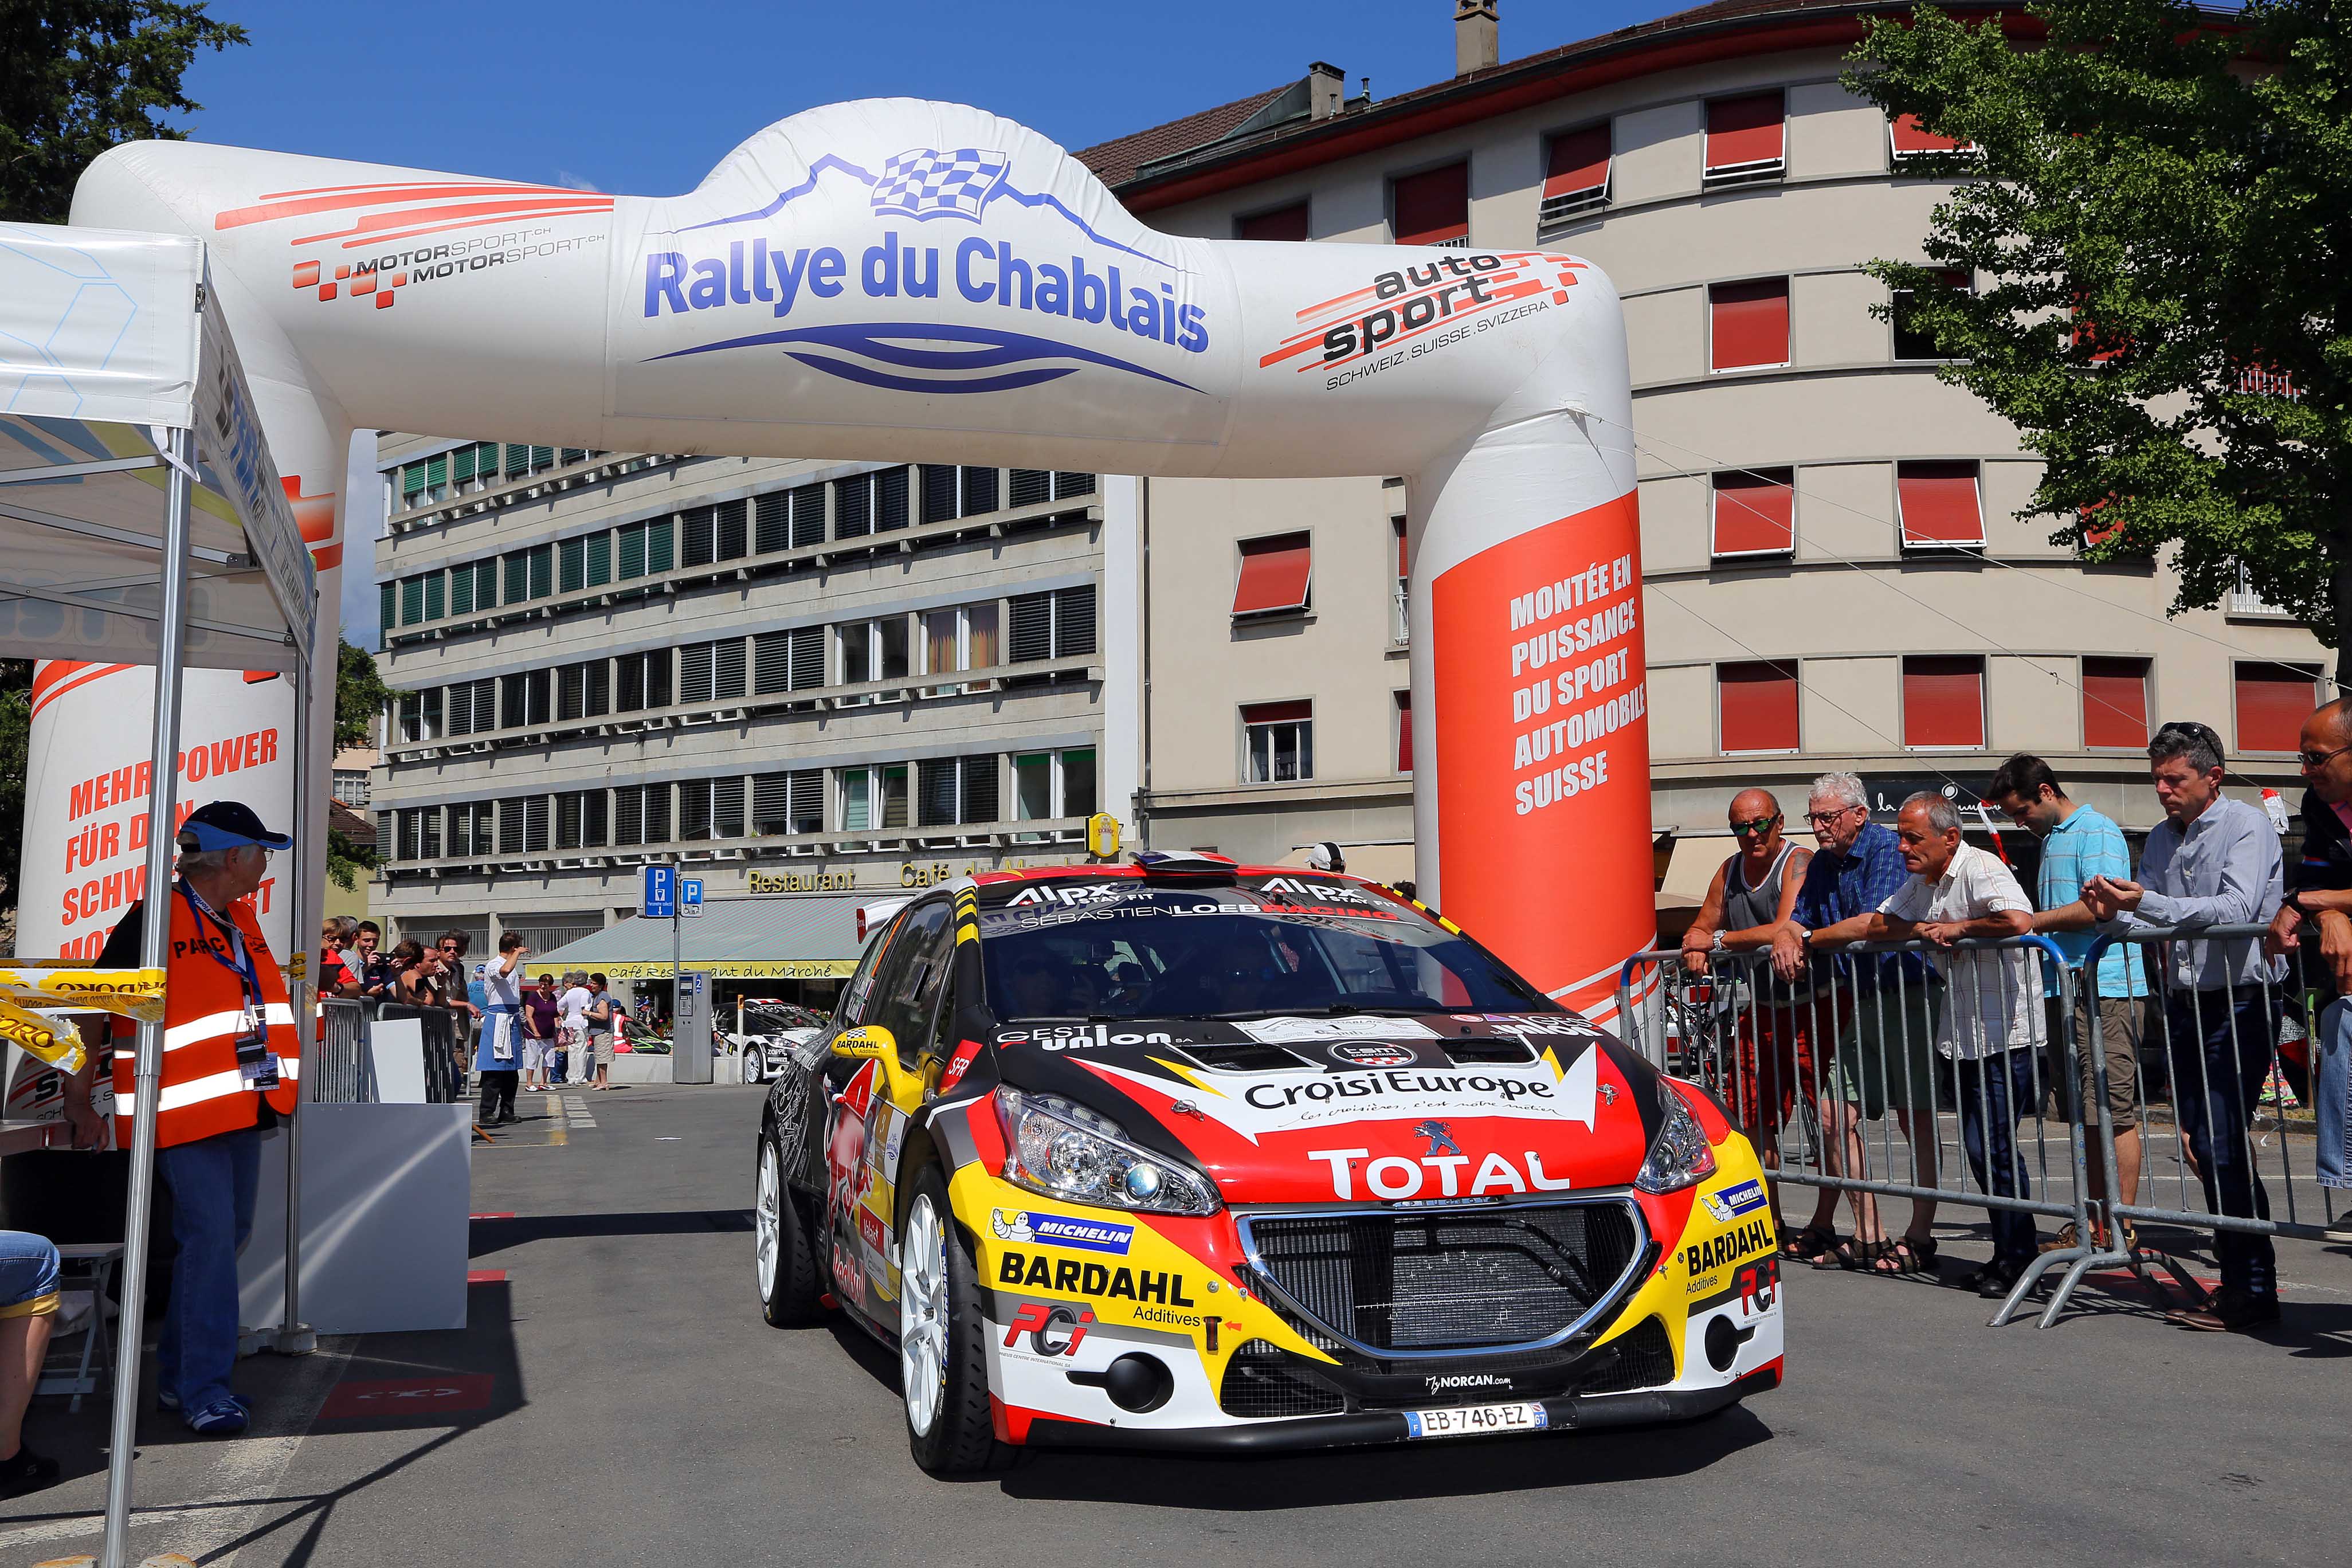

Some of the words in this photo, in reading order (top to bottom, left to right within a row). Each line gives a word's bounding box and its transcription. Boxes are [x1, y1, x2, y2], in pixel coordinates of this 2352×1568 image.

[1374, 255, 1502, 299] auto
[644, 238, 846, 319] Rallye
[861, 232, 939, 298] du
[955, 237, 1209, 353] Chablais
[1323, 276, 1493, 362] sport
[1510, 562, 1609, 631] MONTÉE
[1613, 554, 1632, 591] EN
[1511, 597, 1636, 677] PUISSANCE
[1513, 678, 1551, 724] DU
[1558, 647, 1628, 705] SPORT
[1514, 681, 1646, 771] AUTOMOBILE
[1515, 750, 1608, 816] SUISSE
[65, 822, 119, 875] FÜR
[655, 869, 666, 889] P
[748, 869, 856, 893] Restaurant
[900, 863, 950, 887] Café
[687, 884, 698, 902] P
[1077, 895, 1122, 904] STAY
[1330, 896, 1368, 904] STAY
[1374, 900, 1398, 908] FIT
[173, 936, 226, 959] PARC
[609, 965, 641, 978] Café
[744, 965, 764, 977] du
[770, 964, 831, 977] Marché
[696, 979, 701, 988] 2
[836, 1040, 880, 1049] BARDAHL
[997, 1025, 1091, 1043] GEST
[1041, 1024, 1171, 1051] union
[948, 1057, 970, 1077] SFR
[1245, 1071, 1554, 1110] CroisiEurope
[1307, 1148, 1571, 1201] TOTAL
[1728, 1185, 1763, 1206] MICHELIN
[1037, 1221, 1131, 1244] MICHELIN
[1687, 1219, 1774, 1277] BARDAHL
[999, 1252, 1194, 1307] BARDAHL
[1685, 1275, 1718, 1295] Additives
[1132, 1306, 1201, 1327] Additives
[1423, 1406, 1527, 1431] EB-746-EZ
[1534, 1414, 1546, 1425] 67
